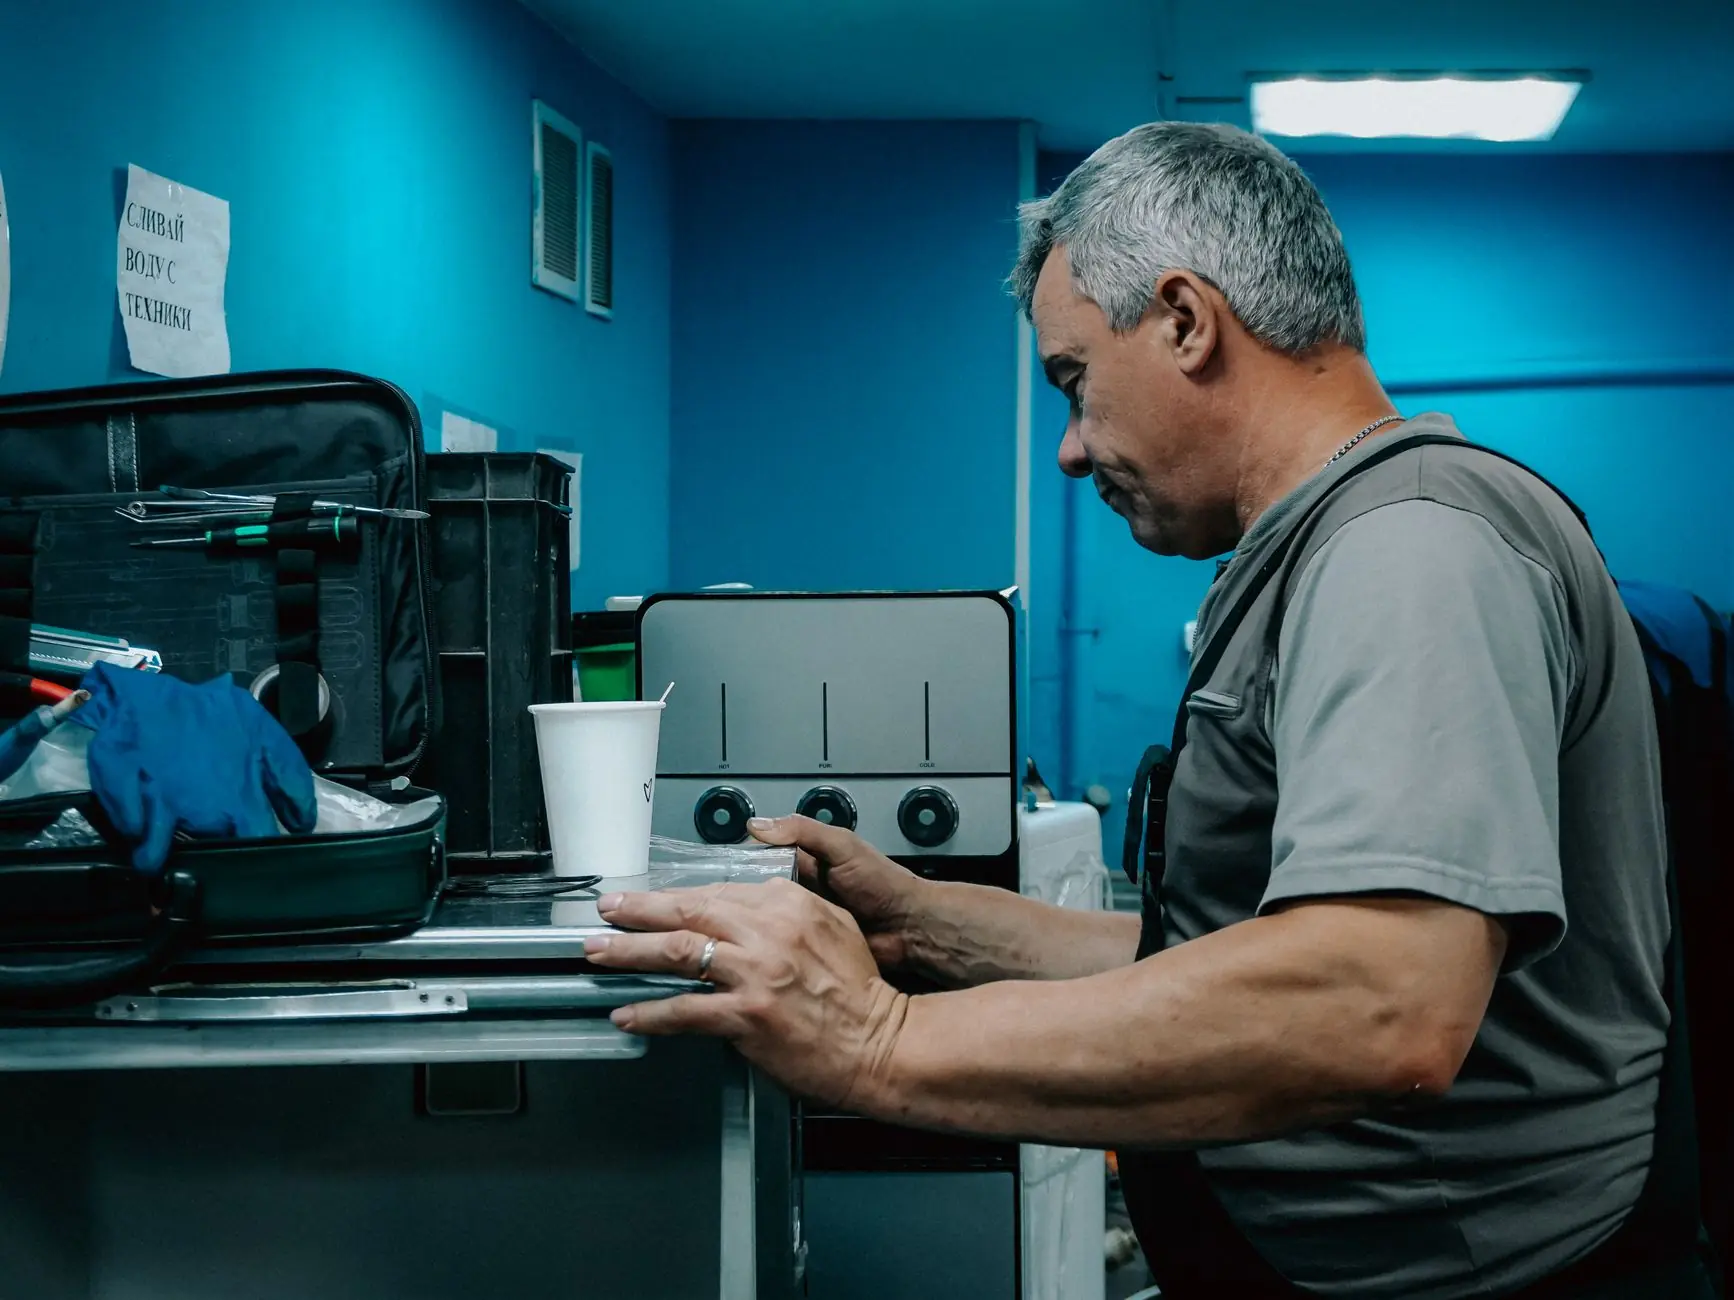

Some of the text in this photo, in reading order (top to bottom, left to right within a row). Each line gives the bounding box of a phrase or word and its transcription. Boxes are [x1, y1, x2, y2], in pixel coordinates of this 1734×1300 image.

[127, 202, 184, 243] СЛИВАЙ
[125, 246, 176, 284] ВОДУ С
[125, 292, 191, 331] ТЕХНИКИ
